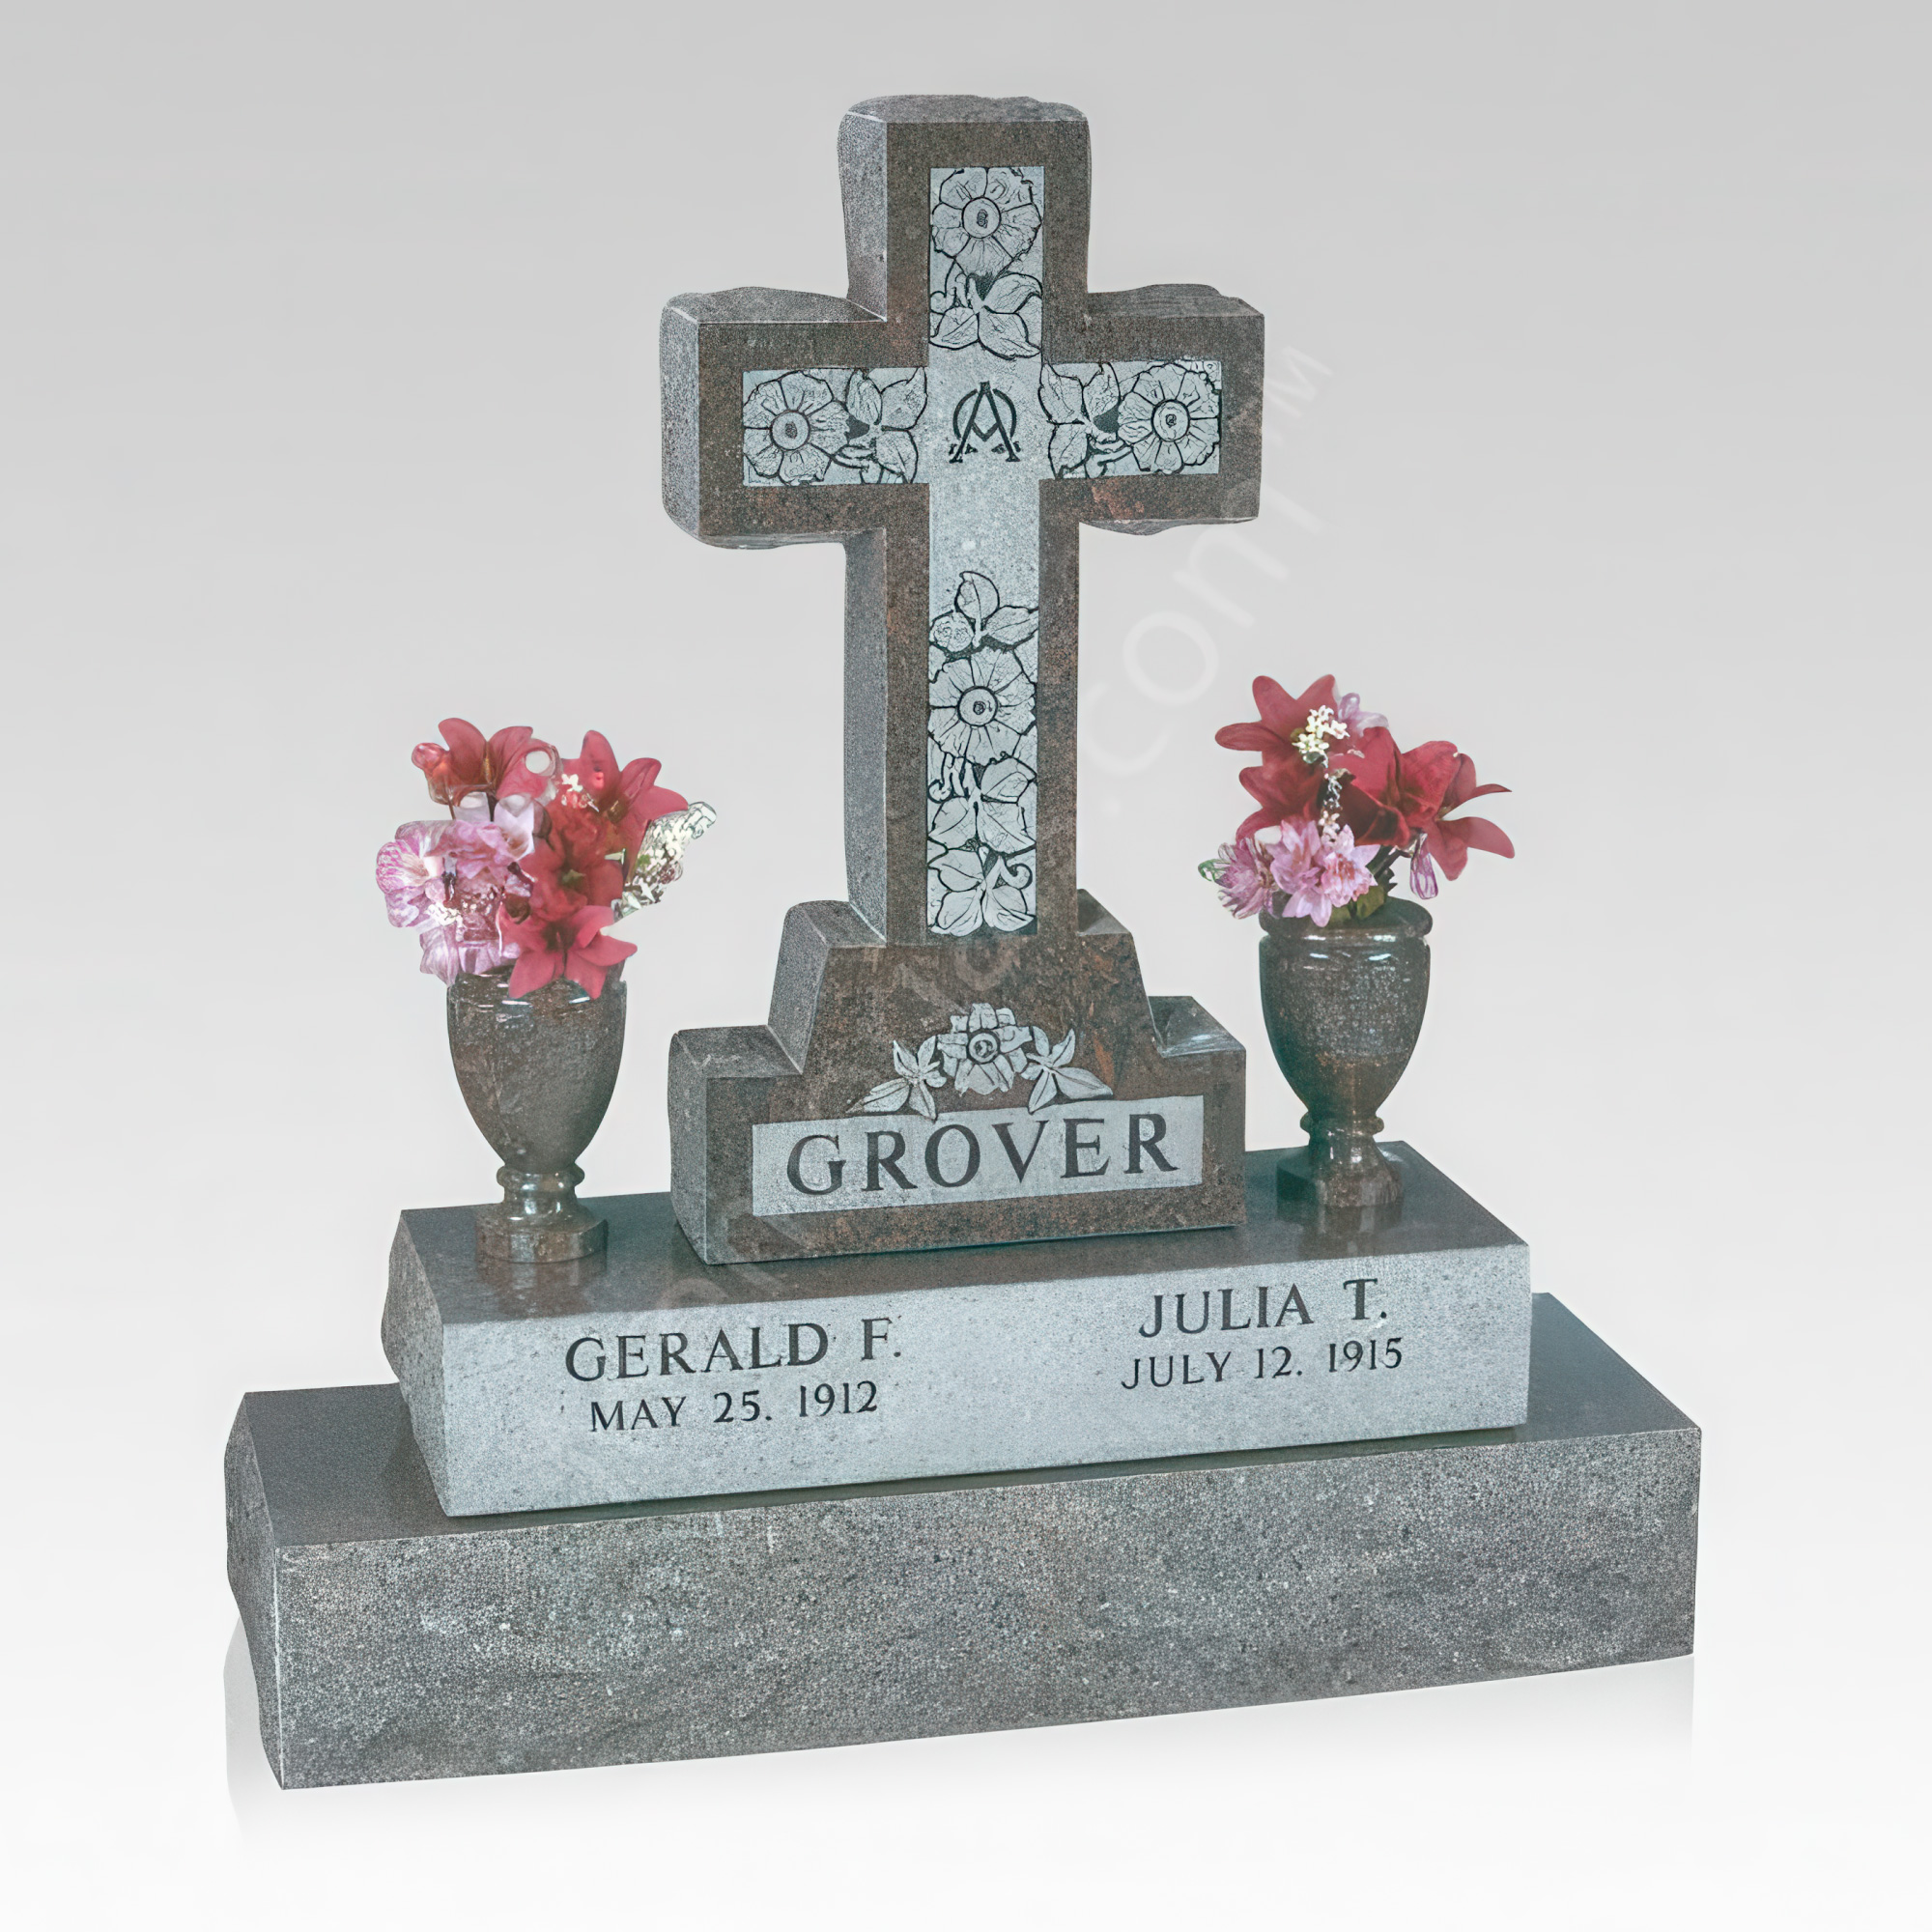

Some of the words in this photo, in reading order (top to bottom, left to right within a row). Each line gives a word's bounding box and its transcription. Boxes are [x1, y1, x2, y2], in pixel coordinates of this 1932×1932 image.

[786, 1112, 1179, 1196] GROVER
[1138, 1283, 1315, 1338] JULIA
[1343, 1277, 1388, 1321] T.
[565, 1322, 829, 1382] GERALD
[861, 1317, 902, 1361] F.
[1121, 1350, 1232, 1390] JULY
[1255, 1346, 1303, 1379] 12.
[1329, 1337, 1404, 1373] 1915
[590, 1396, 687, 1433] MAY
[713, 1390, 773, 1424] 25.
[799, 1380, 878, 1418] 1912
